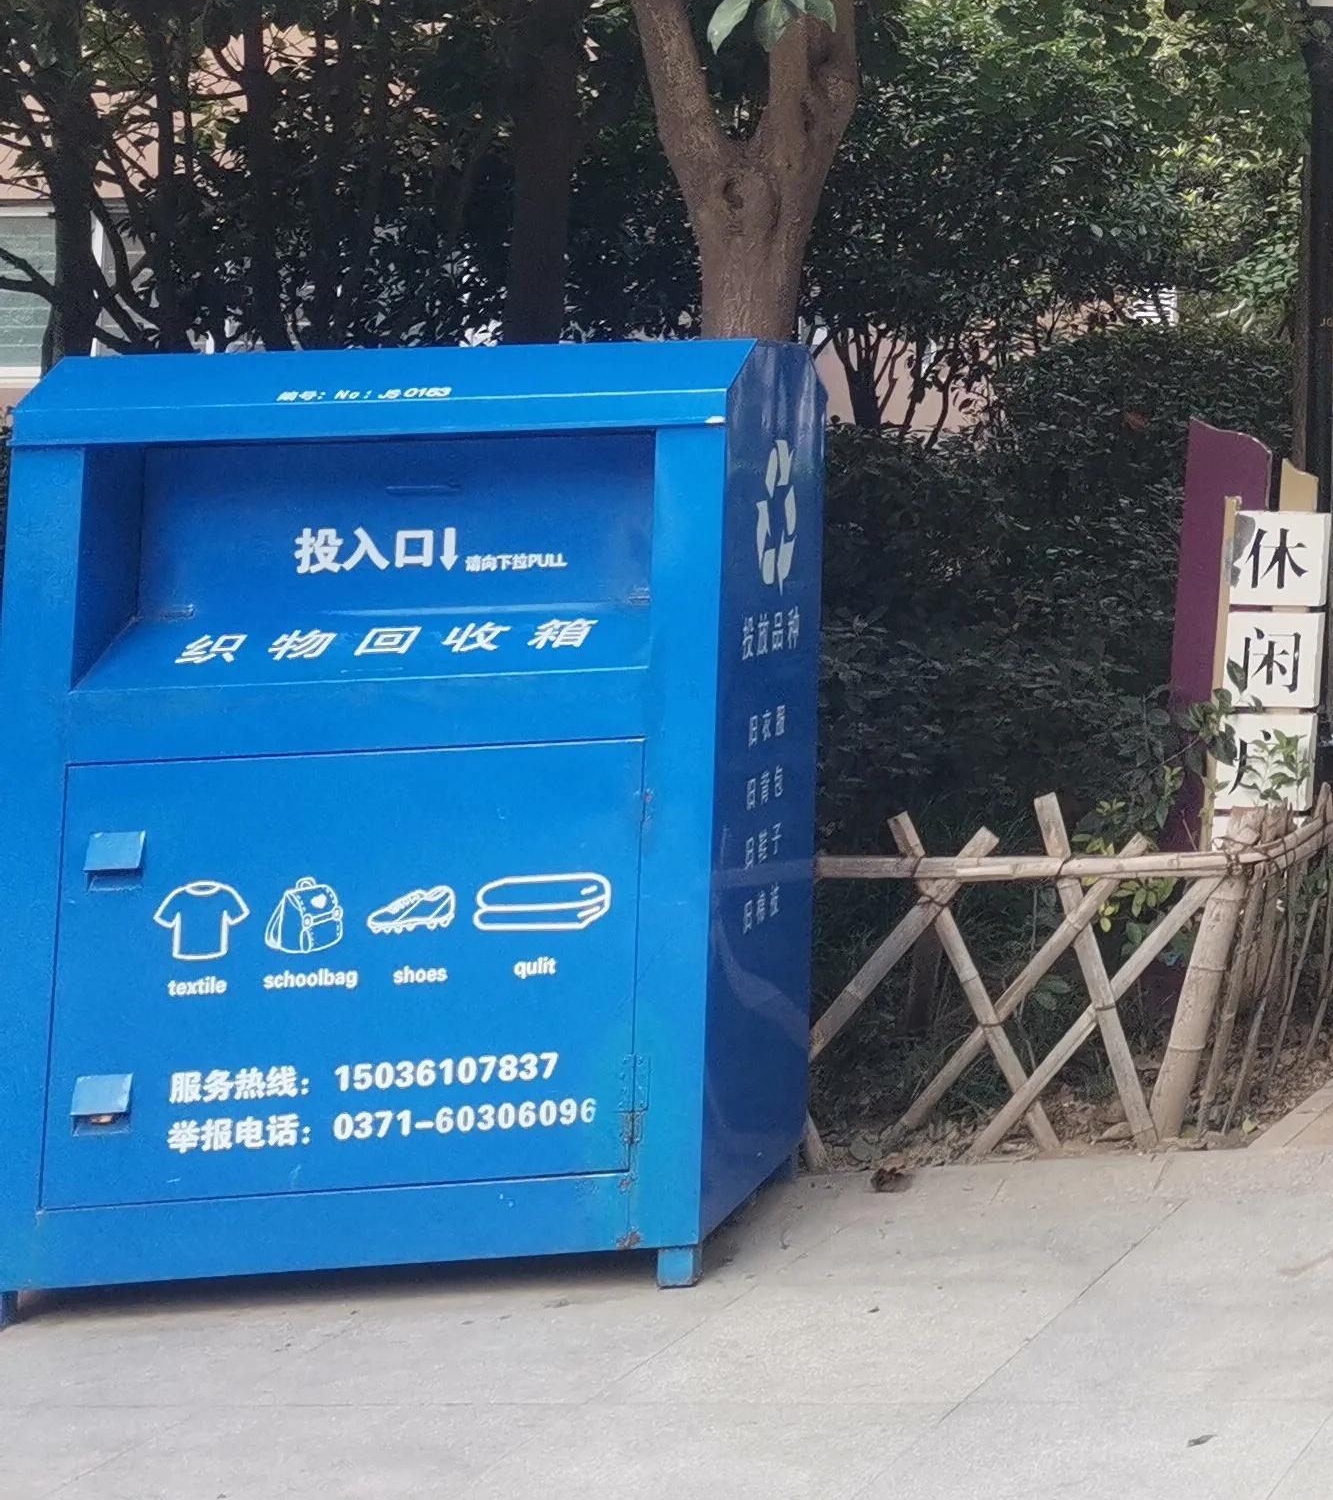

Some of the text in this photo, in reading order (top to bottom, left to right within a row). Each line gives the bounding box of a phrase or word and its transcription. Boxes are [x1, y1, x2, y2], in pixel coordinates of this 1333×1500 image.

[294, 526, 434, 574] 投入口
[174, 618, 599, 665] 织物回收箱
[167, 975, 228, 997] textile
[263, 967, 359, 989] schoolbag
[392, 965, 449, 986] shoes
[334, 1052, 560, 1092] 15036107837
[333, 1097, 598, 1141] 0371-60306096
